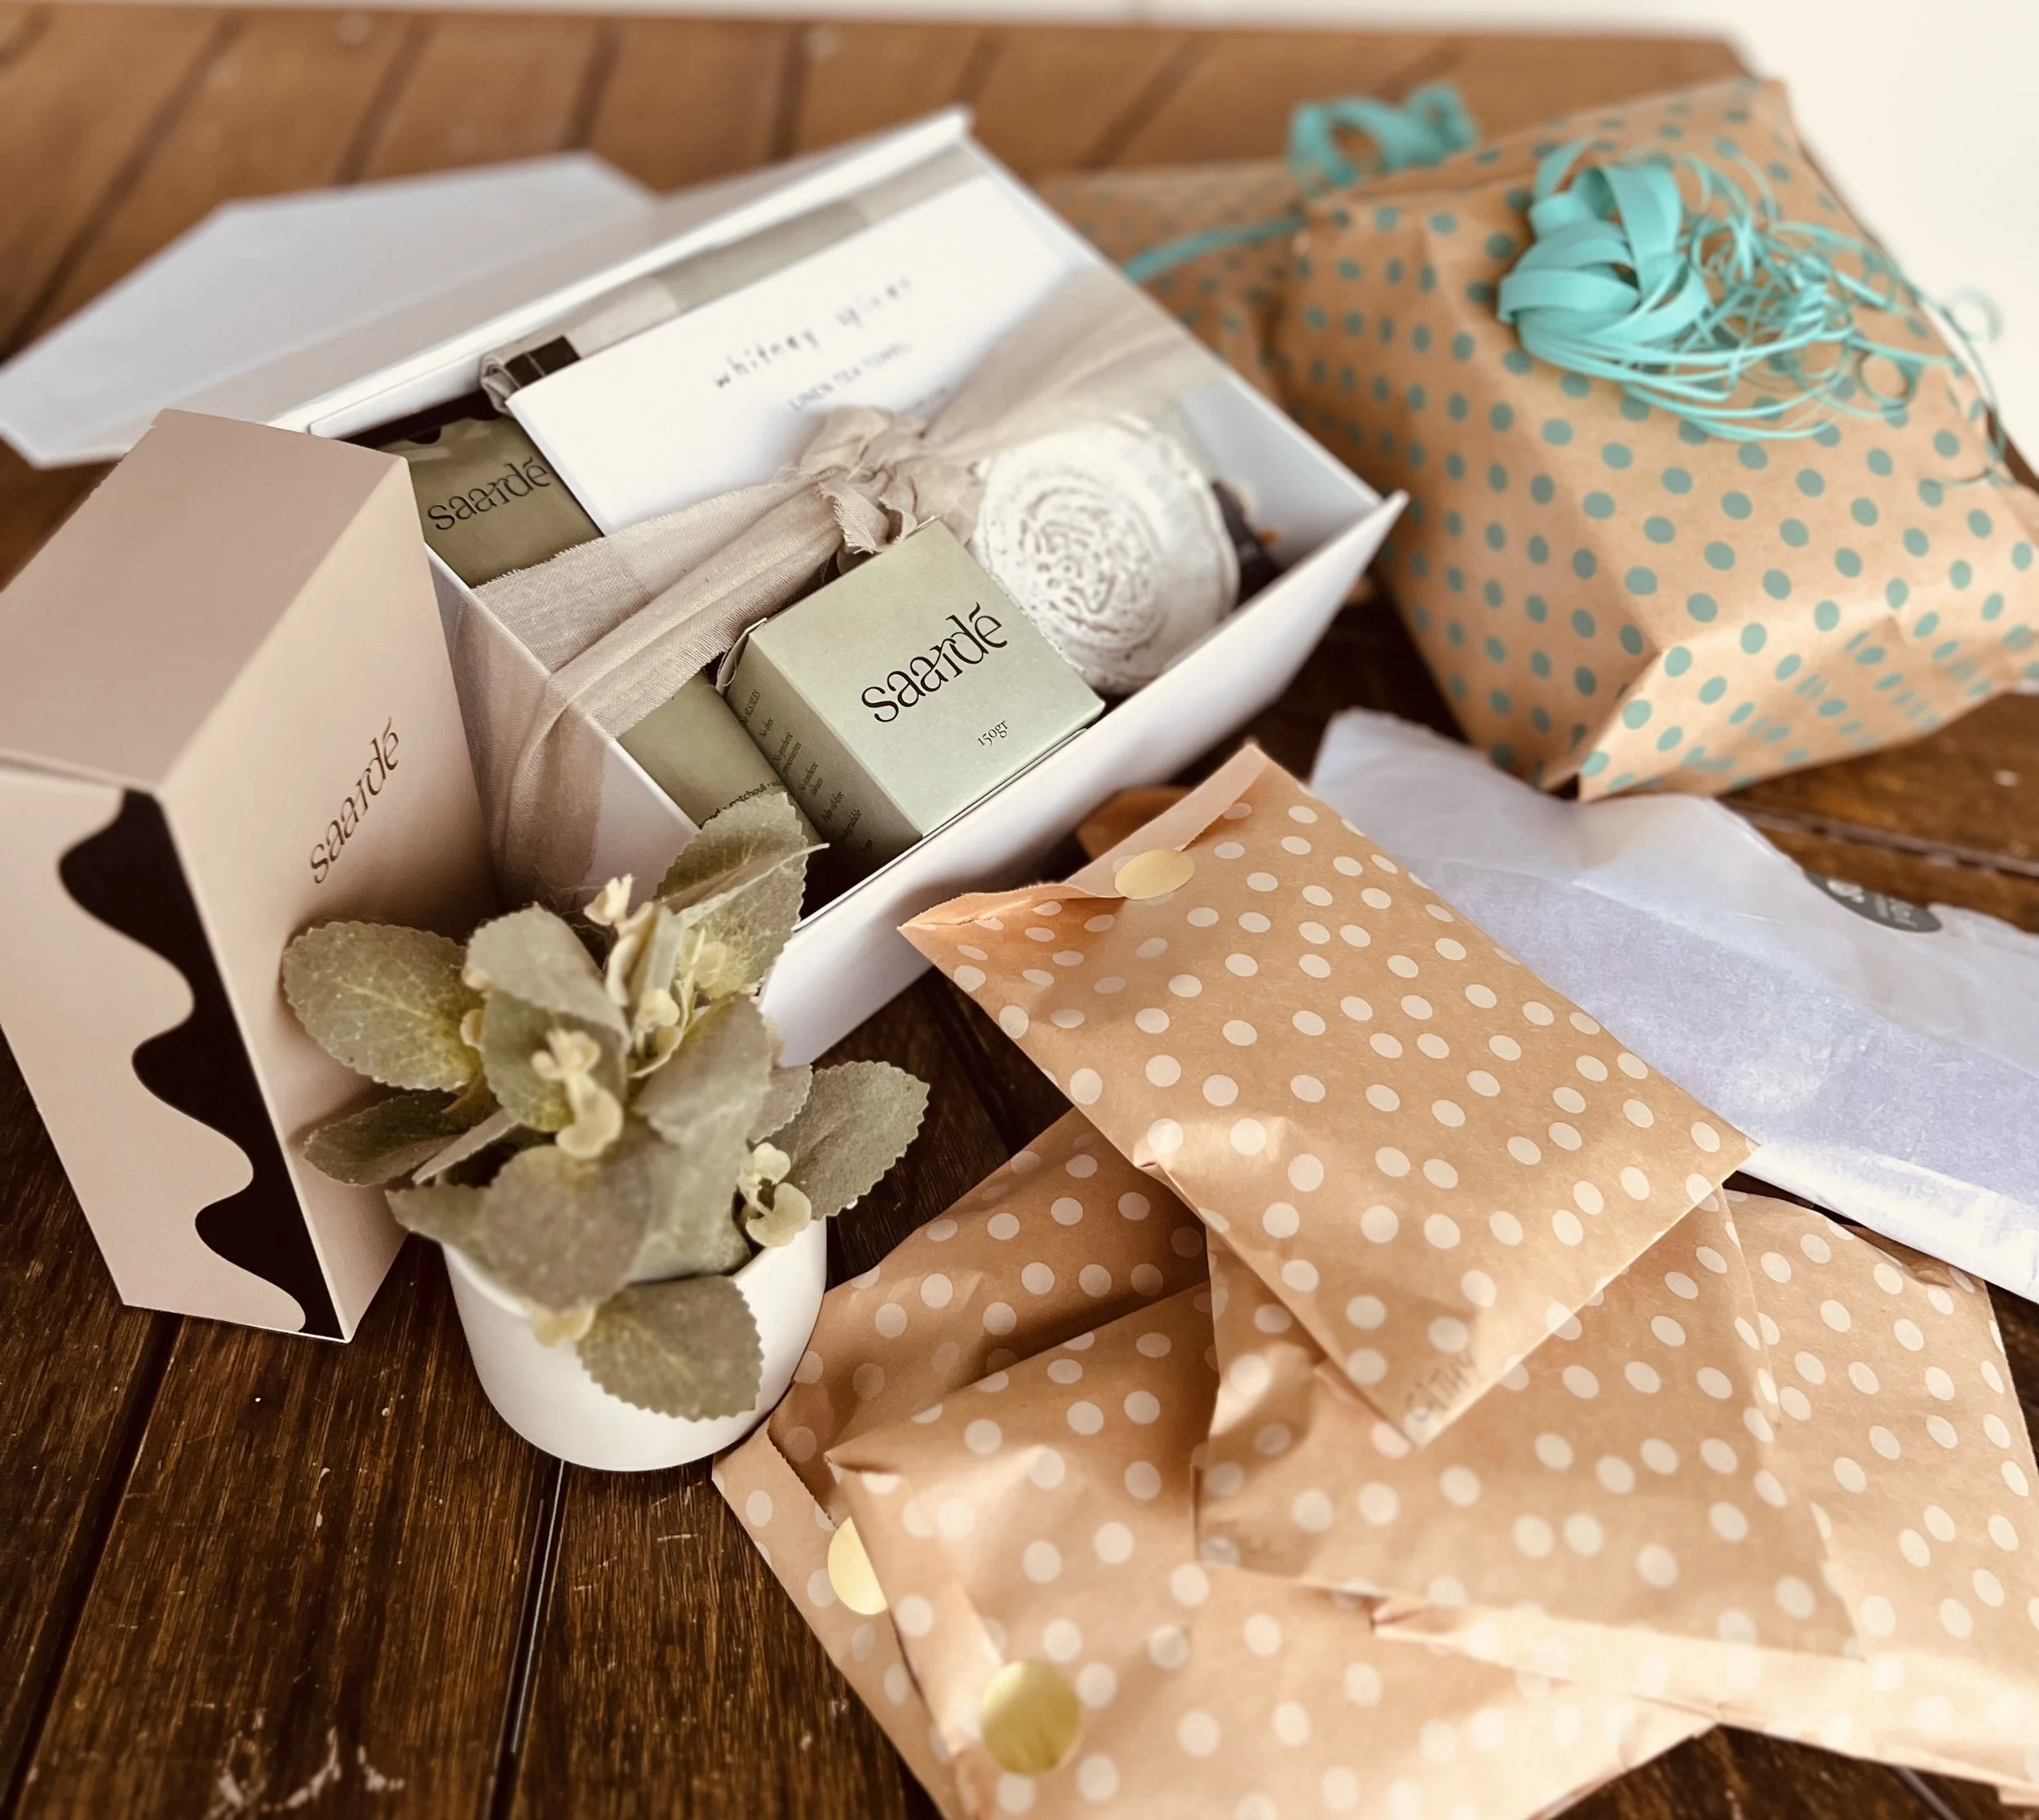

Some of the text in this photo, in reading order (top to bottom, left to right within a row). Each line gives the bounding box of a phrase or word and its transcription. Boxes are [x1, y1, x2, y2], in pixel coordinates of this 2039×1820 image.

[427, 457, 551, 530] saardé
[861, 601, 1008, 722] saardé
[977, 720, 1008, 747] 150gr
[310, 716, 400, 884] saardé
